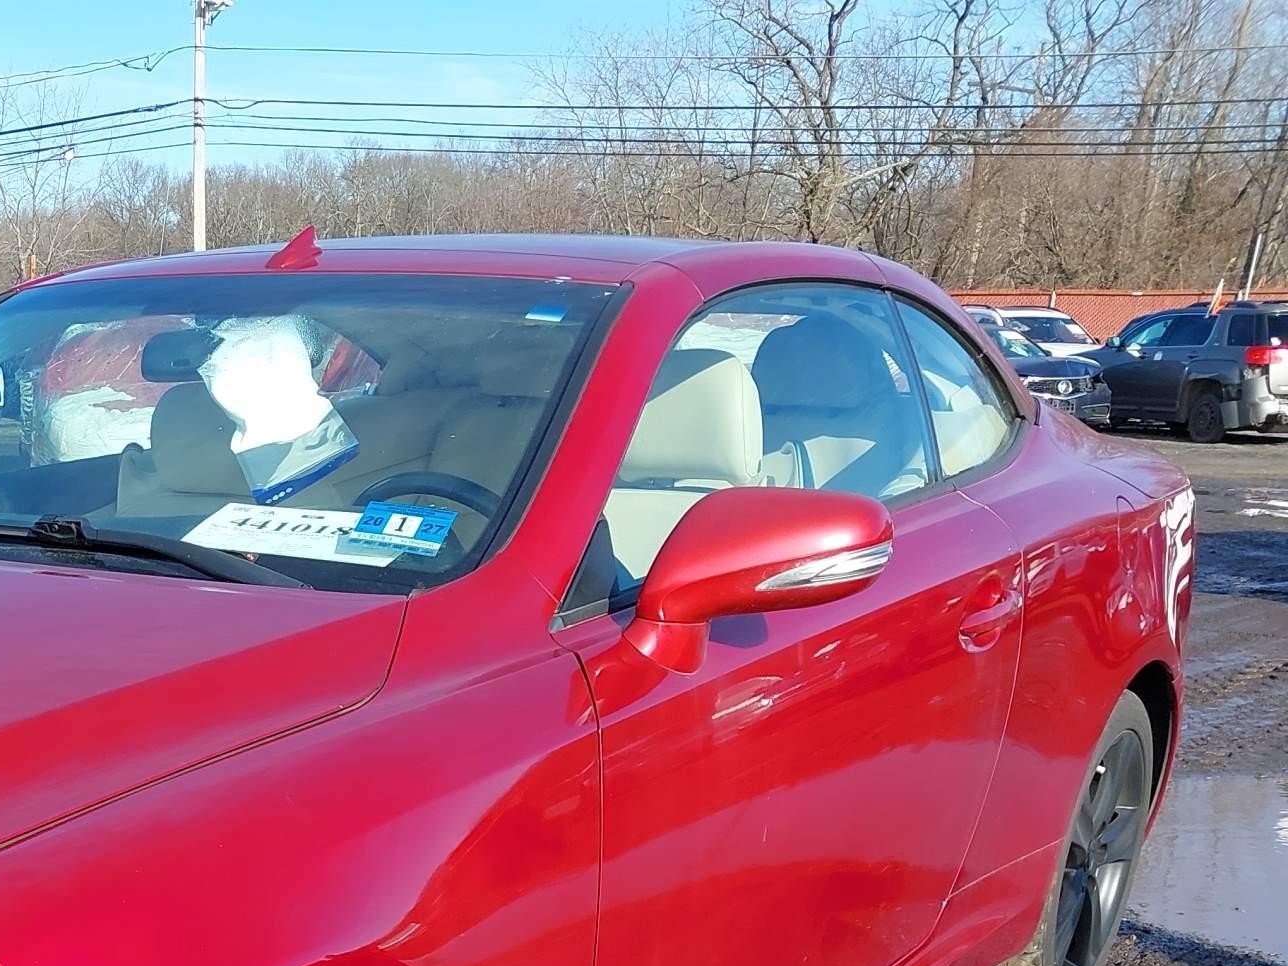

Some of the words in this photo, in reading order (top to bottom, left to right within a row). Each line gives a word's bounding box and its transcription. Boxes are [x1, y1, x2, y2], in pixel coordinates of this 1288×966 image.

[362, 515, 385, 527] 20
[394, 516, 408, 532] 1
[420, 523, 445, 535] 27
